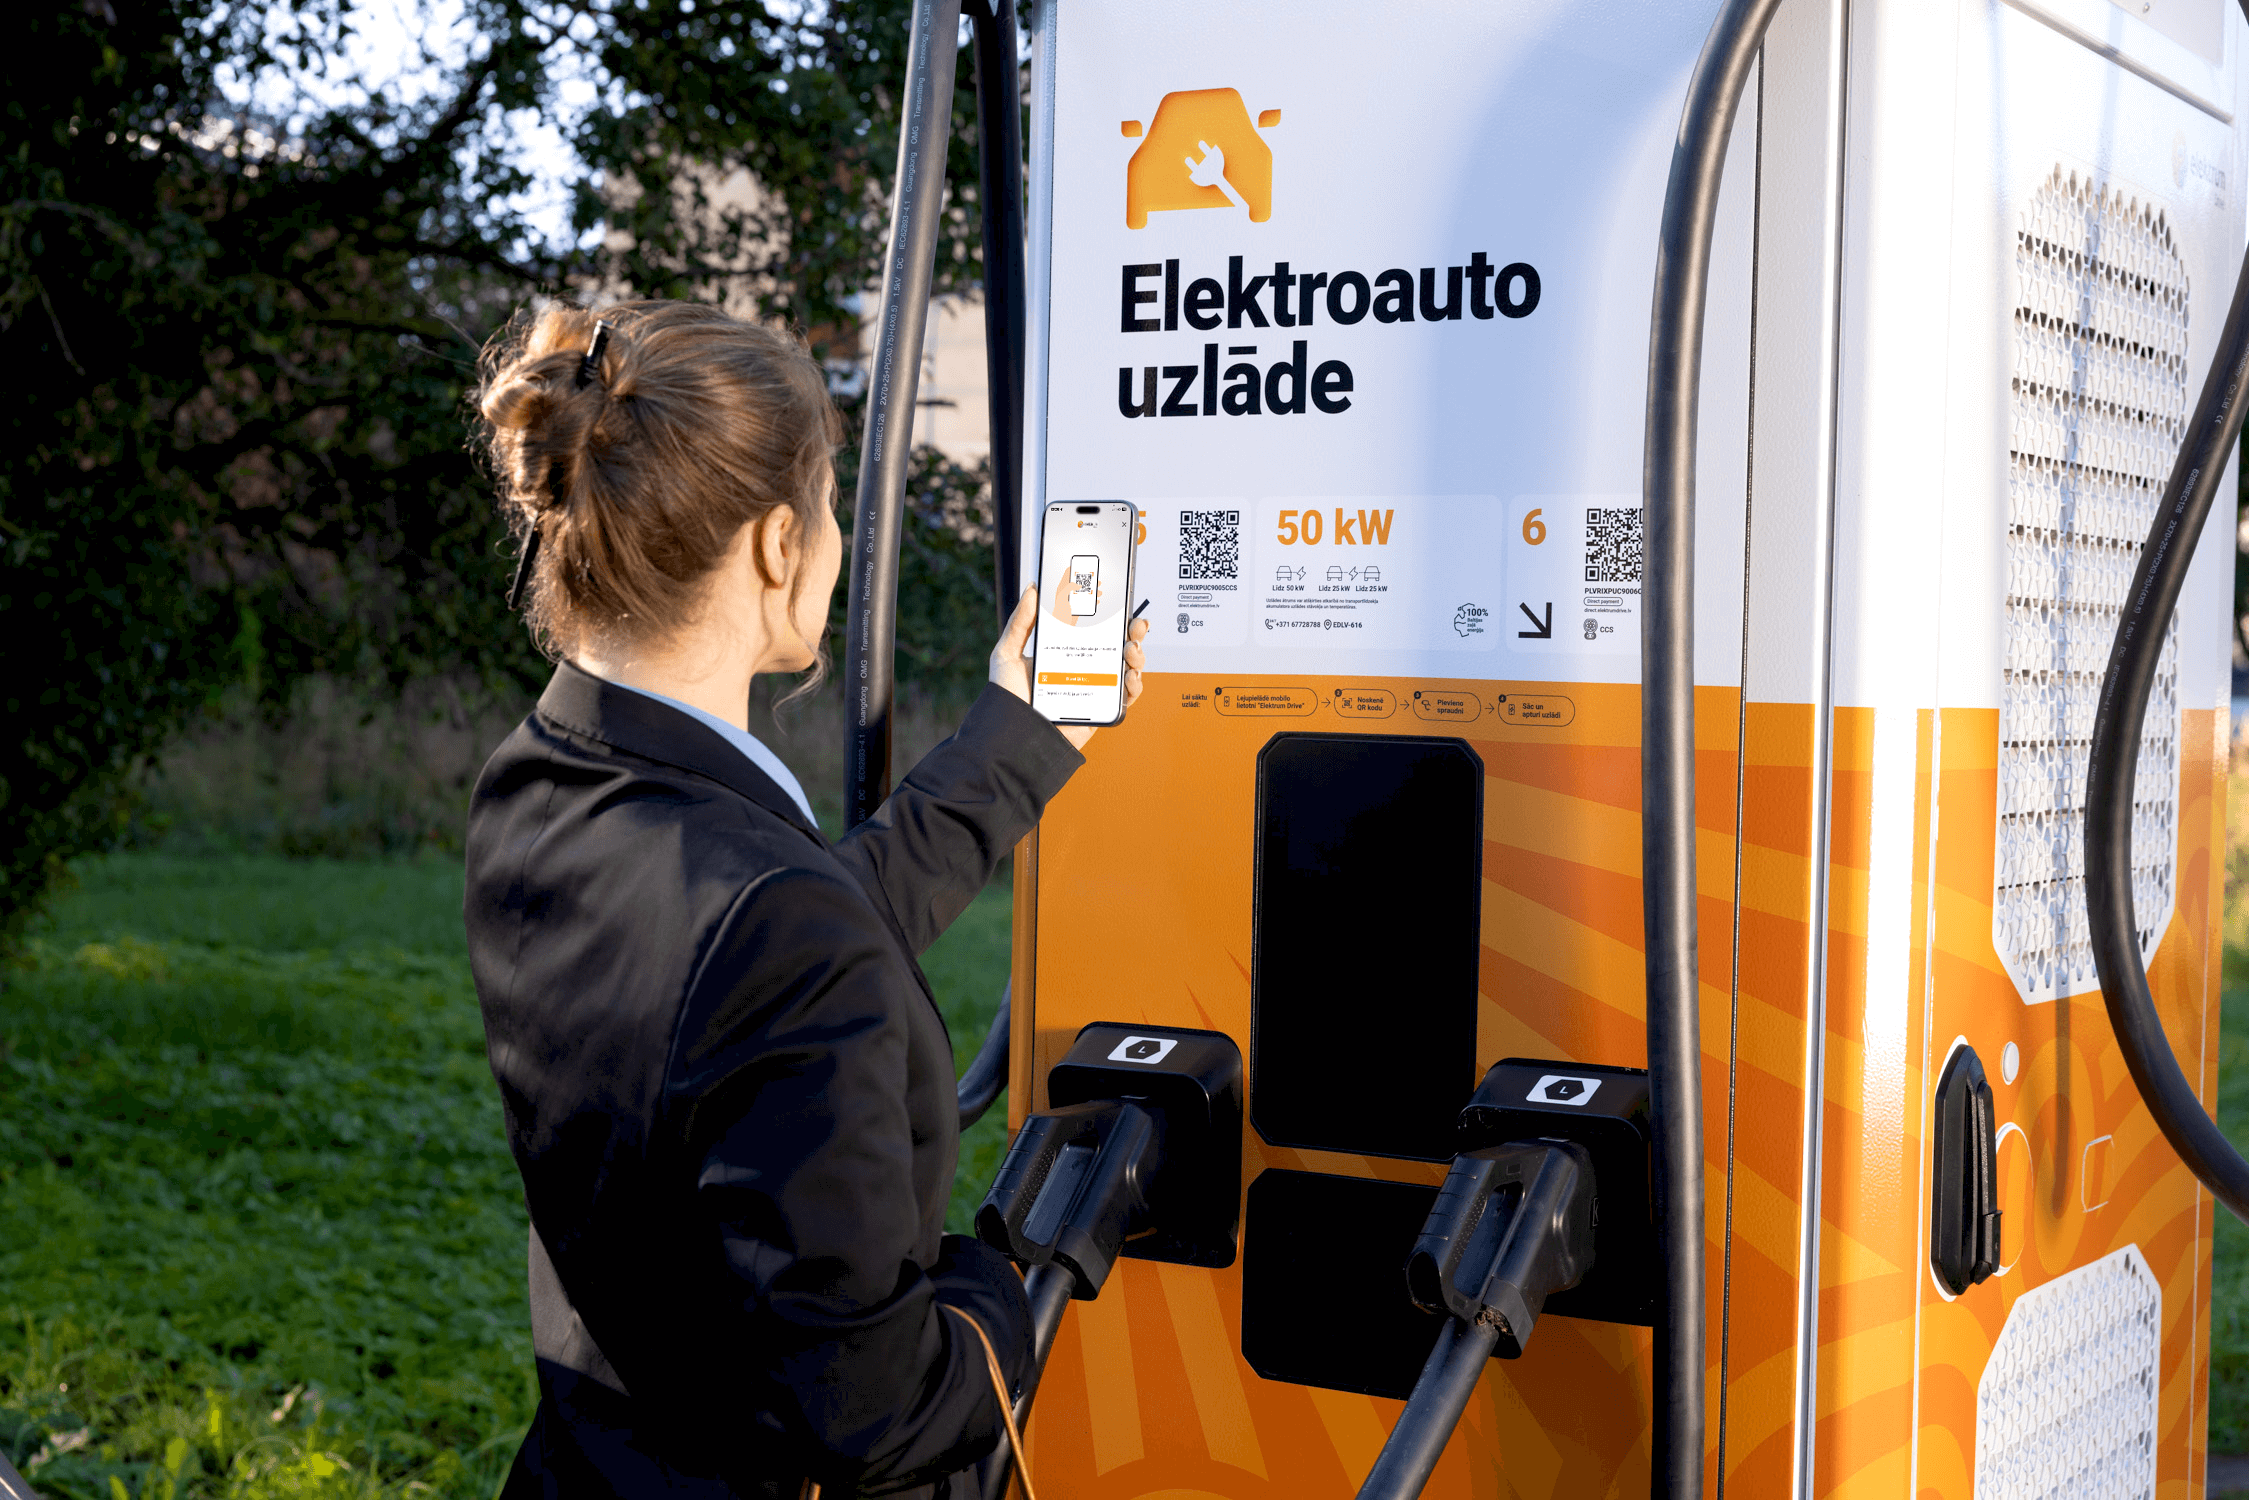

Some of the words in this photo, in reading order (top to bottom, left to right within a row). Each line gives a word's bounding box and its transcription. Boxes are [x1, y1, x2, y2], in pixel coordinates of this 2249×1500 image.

[918, 33, 929, 70] Technology
[914, 77, 926, 118] Transmitting
[911, 126, 919, 144] OMG
[906, 152, 918, 192] Guangdong
[896, 258, 904, 270] DC
[893, 276, 902, 296] 1.5kV
[1120, 251, 1542, 333] Elektroauto
[1118, 339, 1354, 419] uzlāde
[1277, 509, 1323, 545] 50
[1335, 507, 1394, 545] kW
[1522, 508, 1546, 545] 6
[862, 560, 874, 602] Technology
[1467, 608, 1489, 616] 100%
[861, 610, 871, 652] Transmitting
[860, 659, 868, 678] OMG
[2118, 646, 2126, 658] DC
[859, 686, 868, 726] Guangdong
[1522, 711, 1540, 719] apturi
[1138, 1046, 1146, 1054] L
[1559, 1086, 1568, 1094] L
